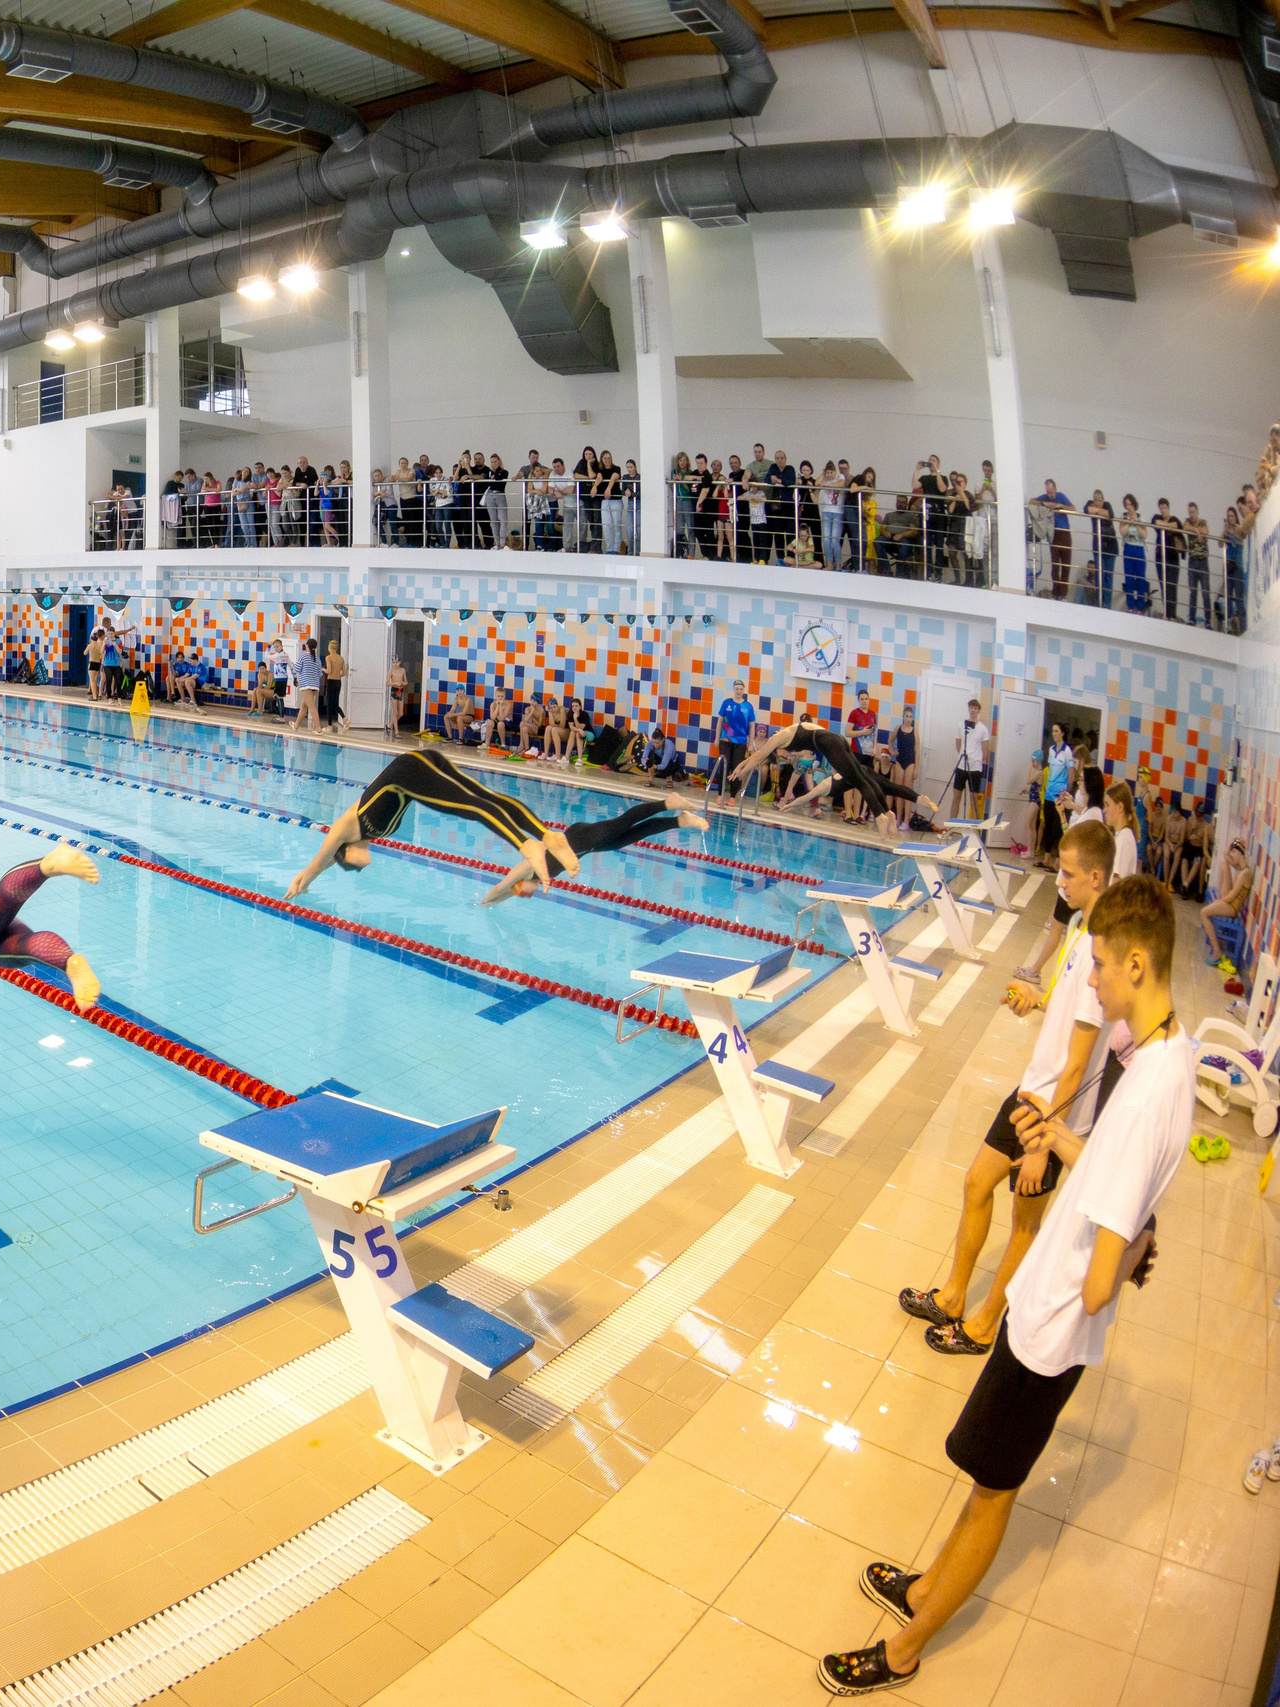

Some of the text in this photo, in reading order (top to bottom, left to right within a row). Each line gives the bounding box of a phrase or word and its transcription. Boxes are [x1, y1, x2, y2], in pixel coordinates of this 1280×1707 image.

[975, 848, 983, 863] 1
[932, 880, 943, 900] 2
[858, 931, 871, 956] 3
[708, 1032, 728, 1064] 4
[733, 1024, 748, 1054] 4
[329, 1229, 356, 1279] 5
[364, 1224, 398, 1279] 5
[837, 1686, 874, 1696] crocs
